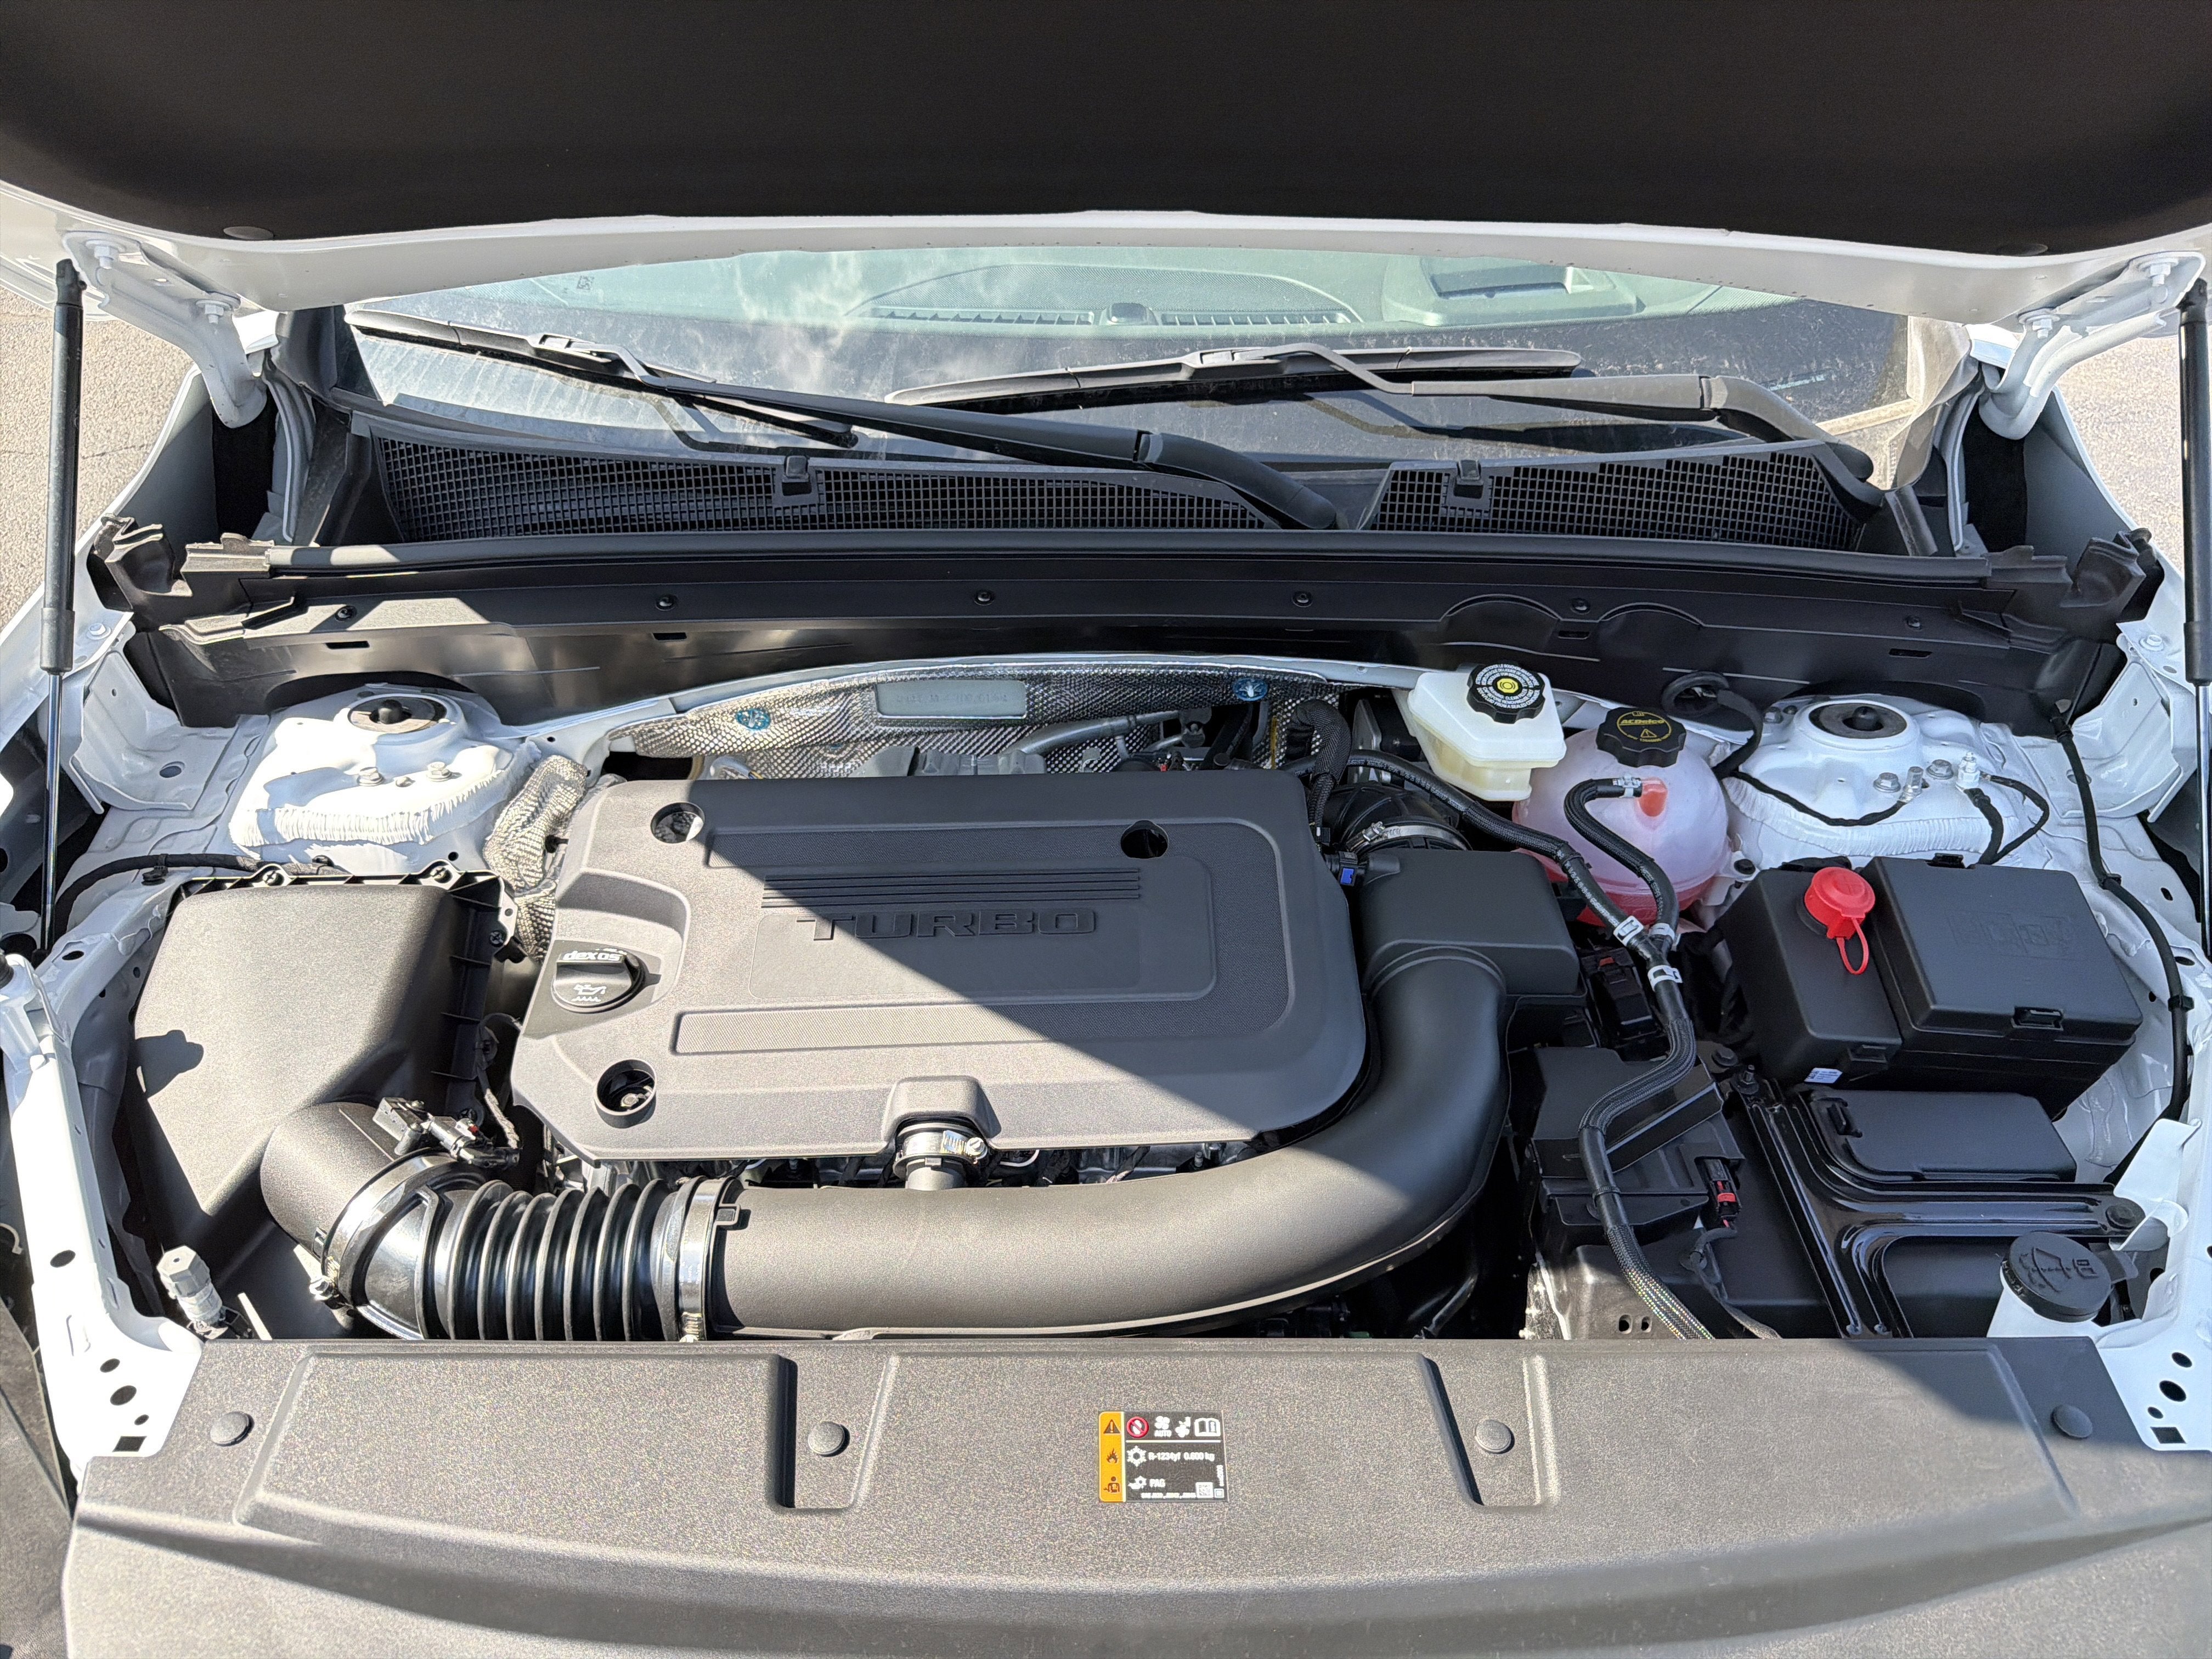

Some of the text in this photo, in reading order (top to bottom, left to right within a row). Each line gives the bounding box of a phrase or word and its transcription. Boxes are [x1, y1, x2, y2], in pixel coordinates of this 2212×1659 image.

[797, 909, 1097, 941] TURBO
[562, 950, 623, 961] dexos
[1148, 1452, 1181, 1462] R-1234yf
[1205, 1452, 1215, 1462] kg
[1149, 1478, 1166, 1488] PAG
